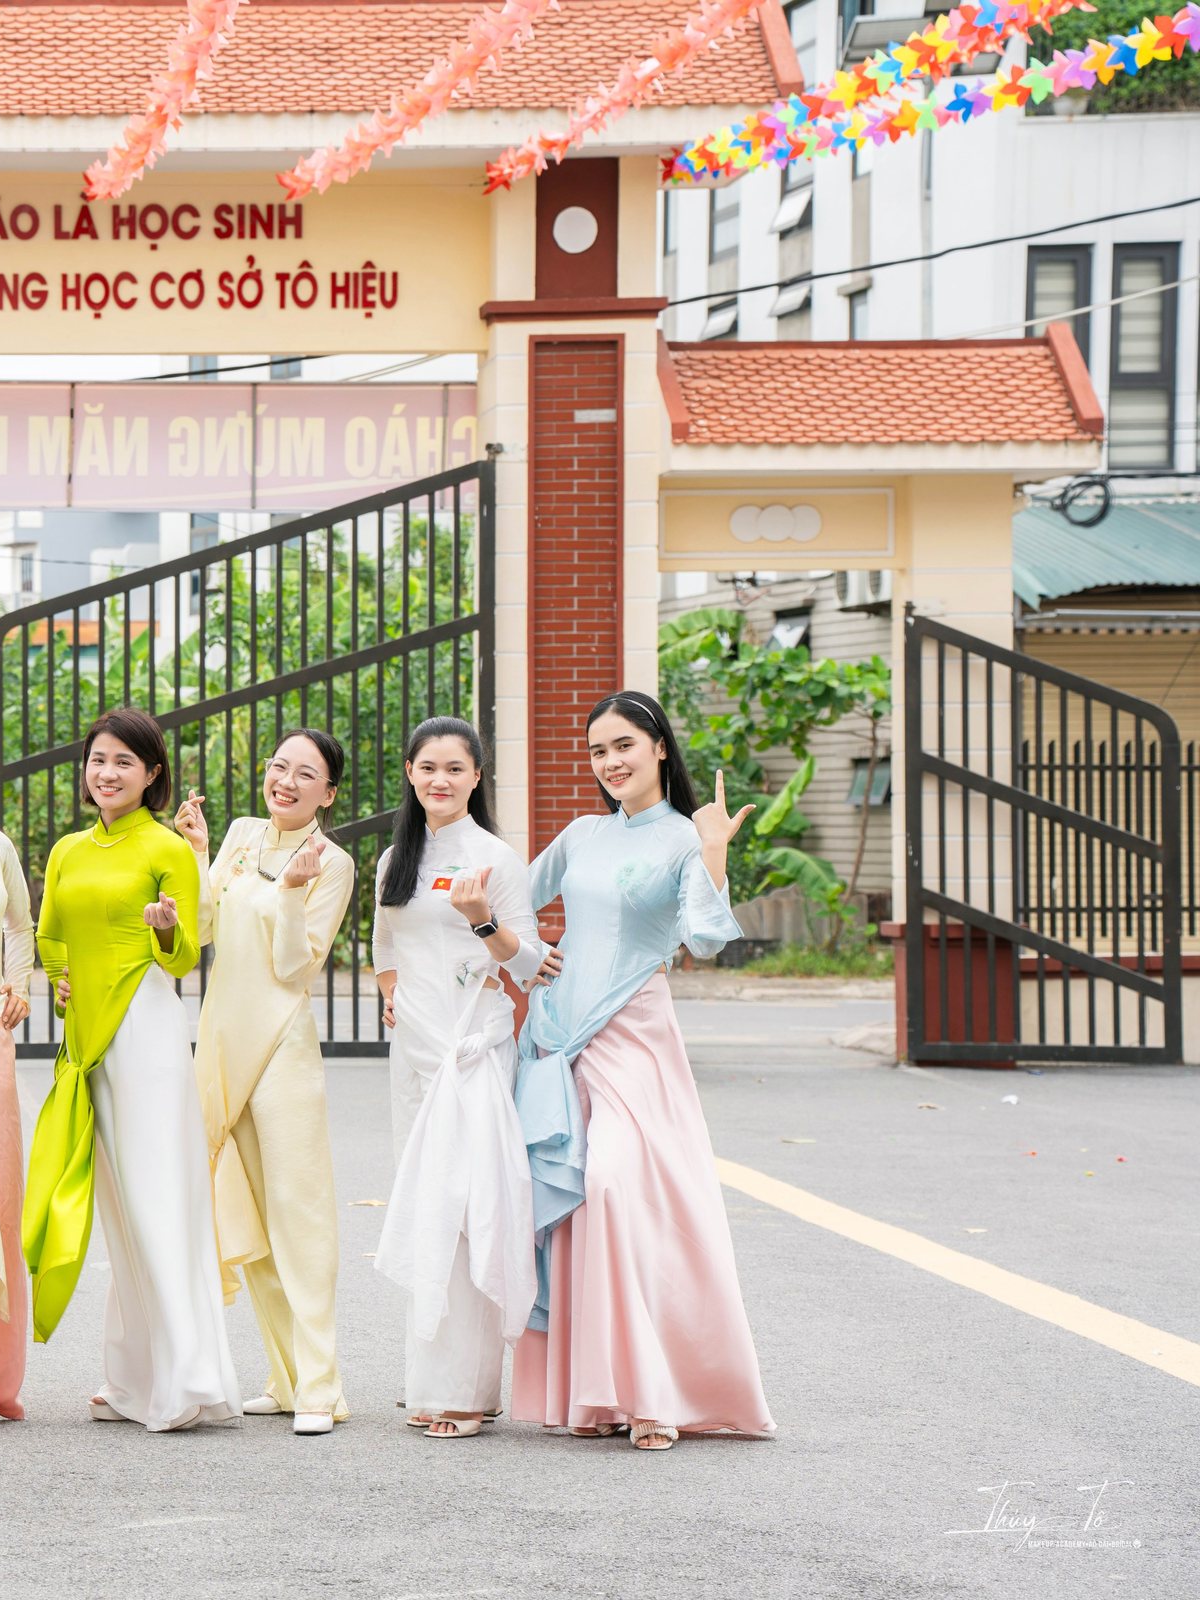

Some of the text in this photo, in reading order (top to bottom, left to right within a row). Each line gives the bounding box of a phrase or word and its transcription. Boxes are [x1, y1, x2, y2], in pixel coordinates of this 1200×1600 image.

[53, 191, 99, 240] LÀ
[111, 203, 201, 251] HỌC
[213, 203, 303, 240] SINH
[61, 271, 138, 319] HỌC
[150, 269, 205, 309] CƠ
[217, 255, 264, 309] SỞ
[275, 260, 318, 310] TÔ
[330, 260, 398, 318] HIỆU
